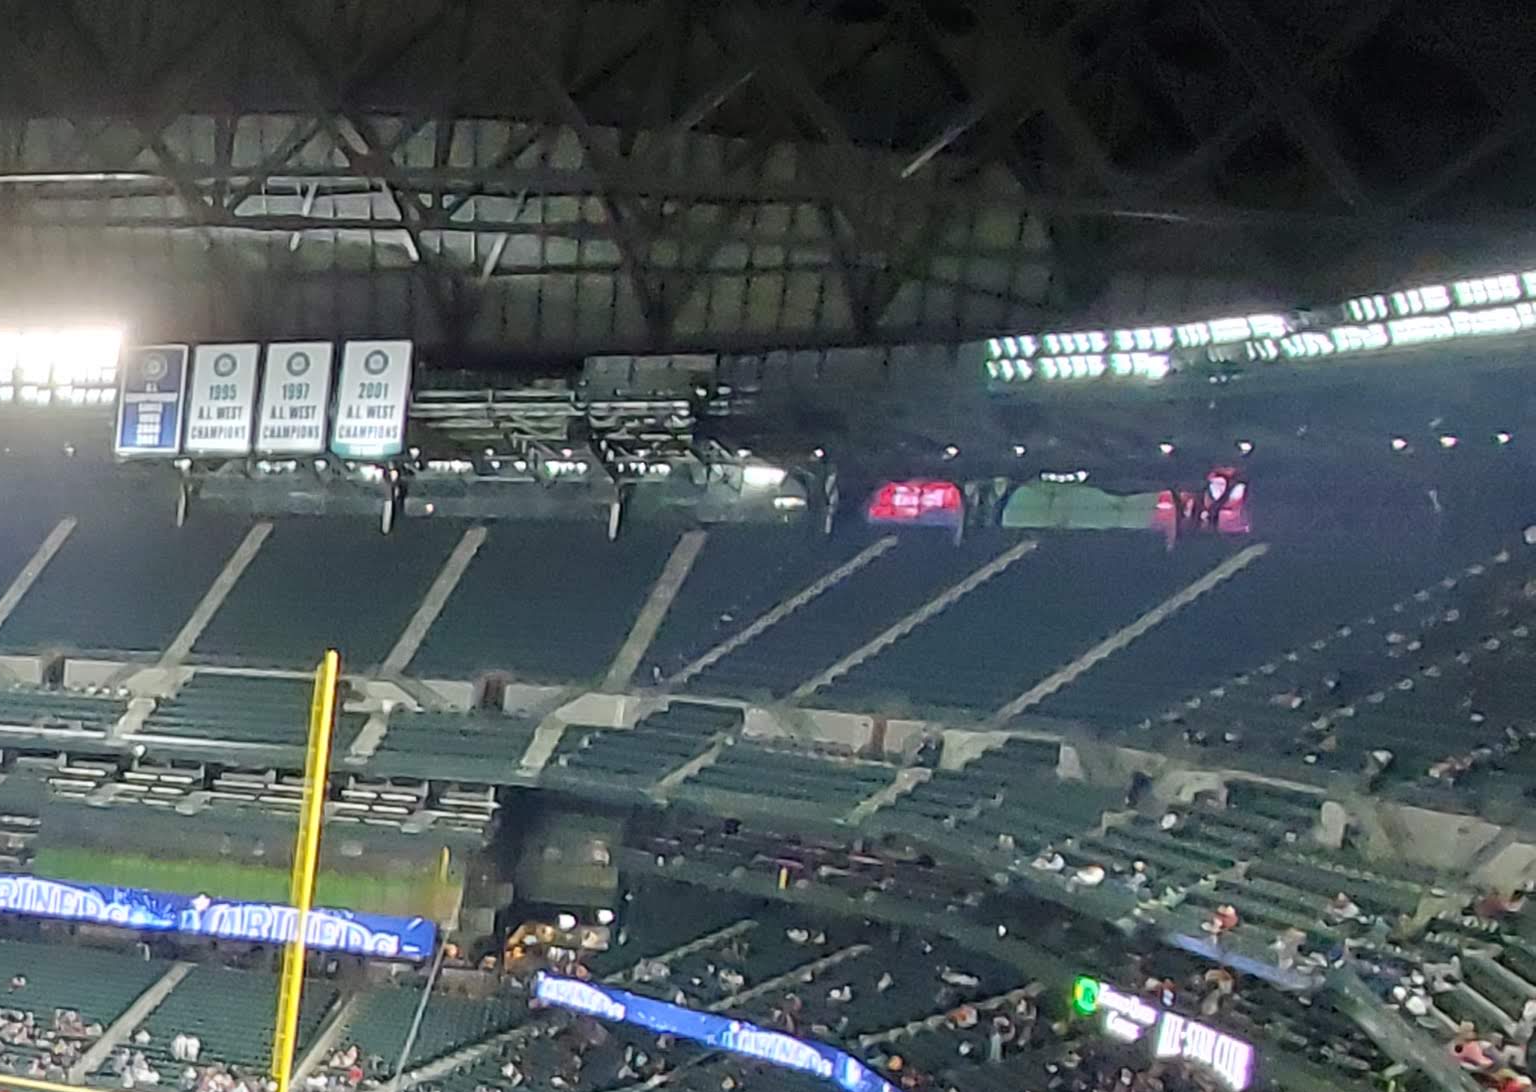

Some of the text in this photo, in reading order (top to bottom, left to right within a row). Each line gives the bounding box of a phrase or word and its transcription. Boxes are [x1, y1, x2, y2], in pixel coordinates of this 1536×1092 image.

[209, 384, 237, 400] 1995
[282, 383, 310, 399] 1997
[358, 382, 388, 398] 2001
[216, 406, 243, 419] WEST
[289, 405, 317, 419] WEST
[366, 405, 395, 419] WEST
[190, 425, 246, 440] CHAMPIONS
[263, 424, 320, 440] CHAMPIONS
[338, 424, 398, 440] CHAMPIONS
